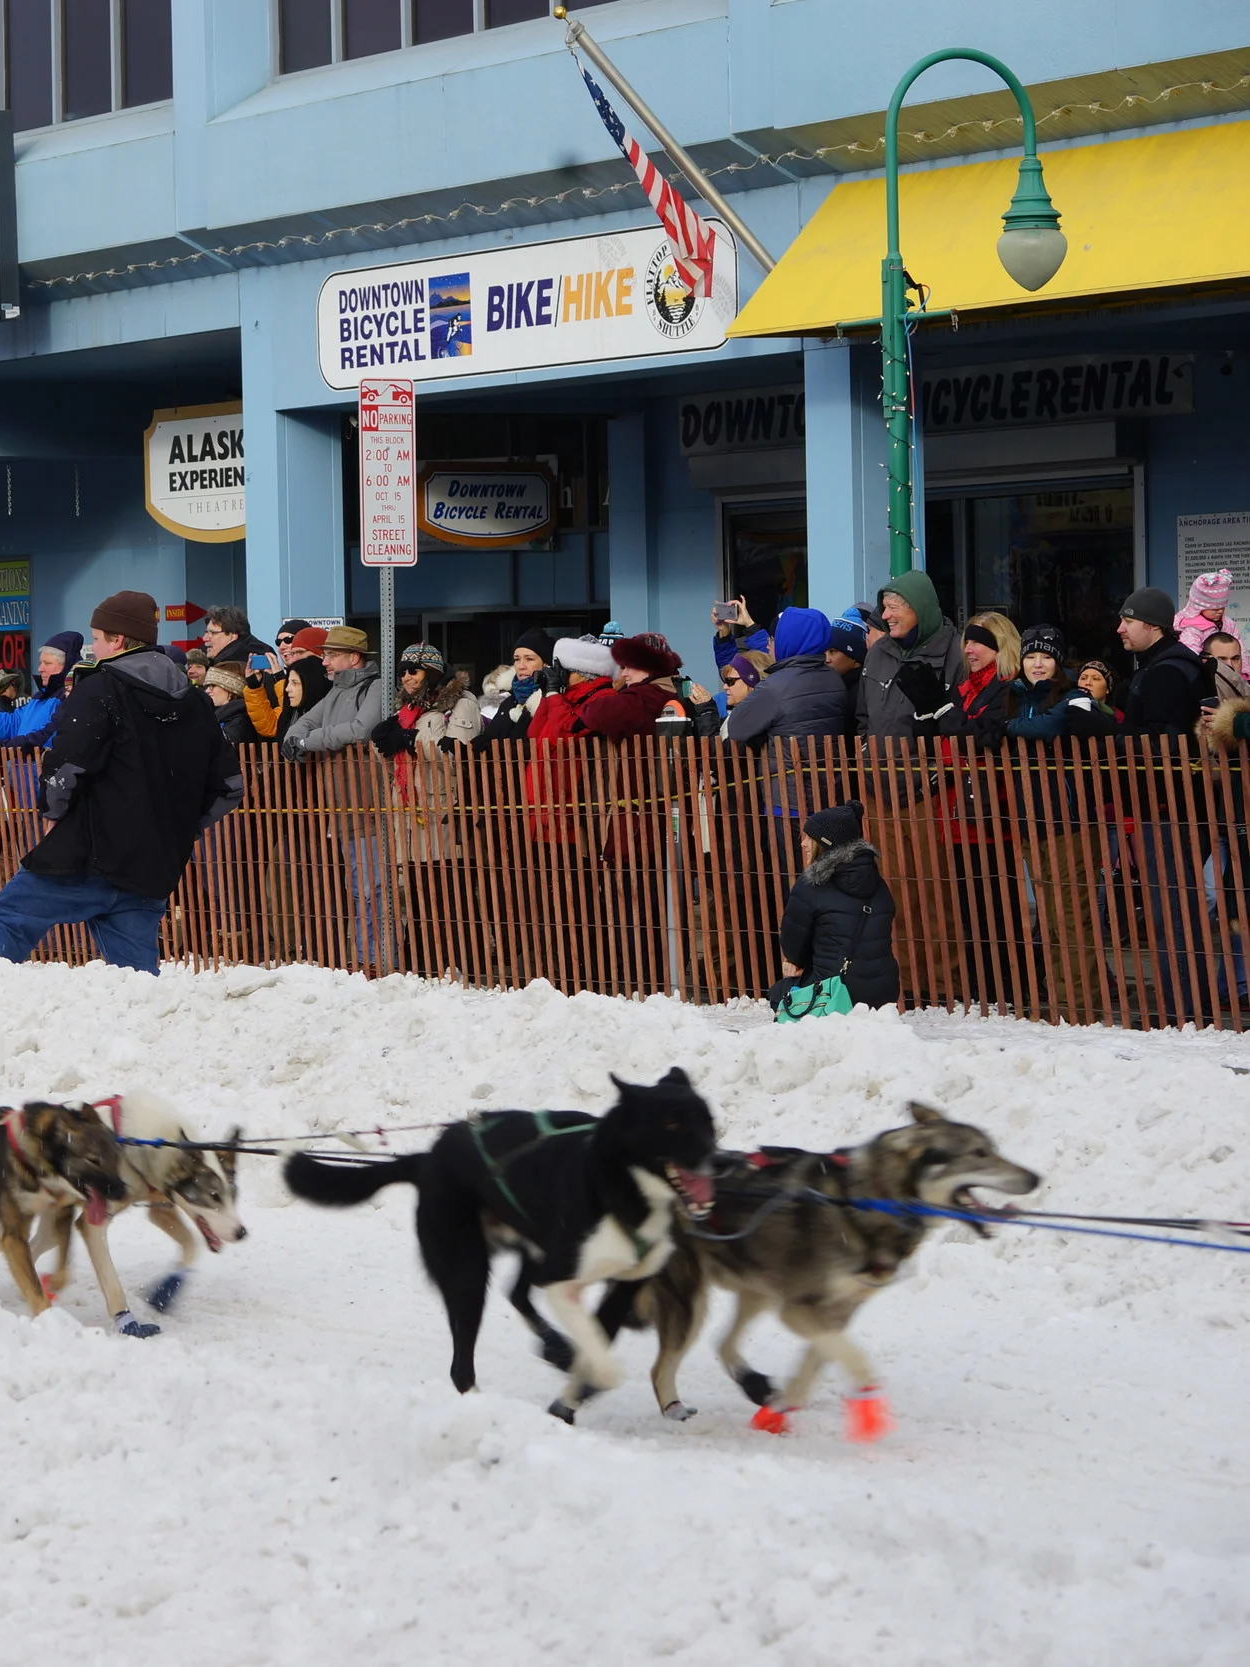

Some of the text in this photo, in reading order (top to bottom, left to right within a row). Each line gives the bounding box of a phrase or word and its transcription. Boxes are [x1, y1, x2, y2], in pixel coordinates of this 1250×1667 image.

[338, 278, 425, 315] DOWNTOWN
[339, 308, 426, 343] BICYCLE
[657, 315, 695, 337] SHUTTLE
[340, 338, 427, 370] RENTAL
[681, 356, 1174, 448] DOWNTO ICYCLE RENTAL
[362, 410, 412, 428] NO PARKING
[168, 428, 245, 465] ALASK
[370, 436, 405, 444] THIS BLOCK
[366, 450, 410, 461] 2:00 AM
[384, 464, 392, 473] TO
[169, 465, 245, 493] EXPERIEN
[366, 476, 410, 487] 6:00 AM
[375, 492, 402, 501] OCT 15
[447, 480, 527, 498] DOWNTOWN
[188, 498, 245, 514] THEATRE
[433, 501, 543, 519] BICYCLE RENTAL
[372, 515, 405, 524] APRIL 15
[1179, 518, 1221, 527] ANCHORAGE
[372, 529, 406, 541] STREET
[366, 544, 412, 556] CLEANING
[165, 607, 186, 618] INSIDE
